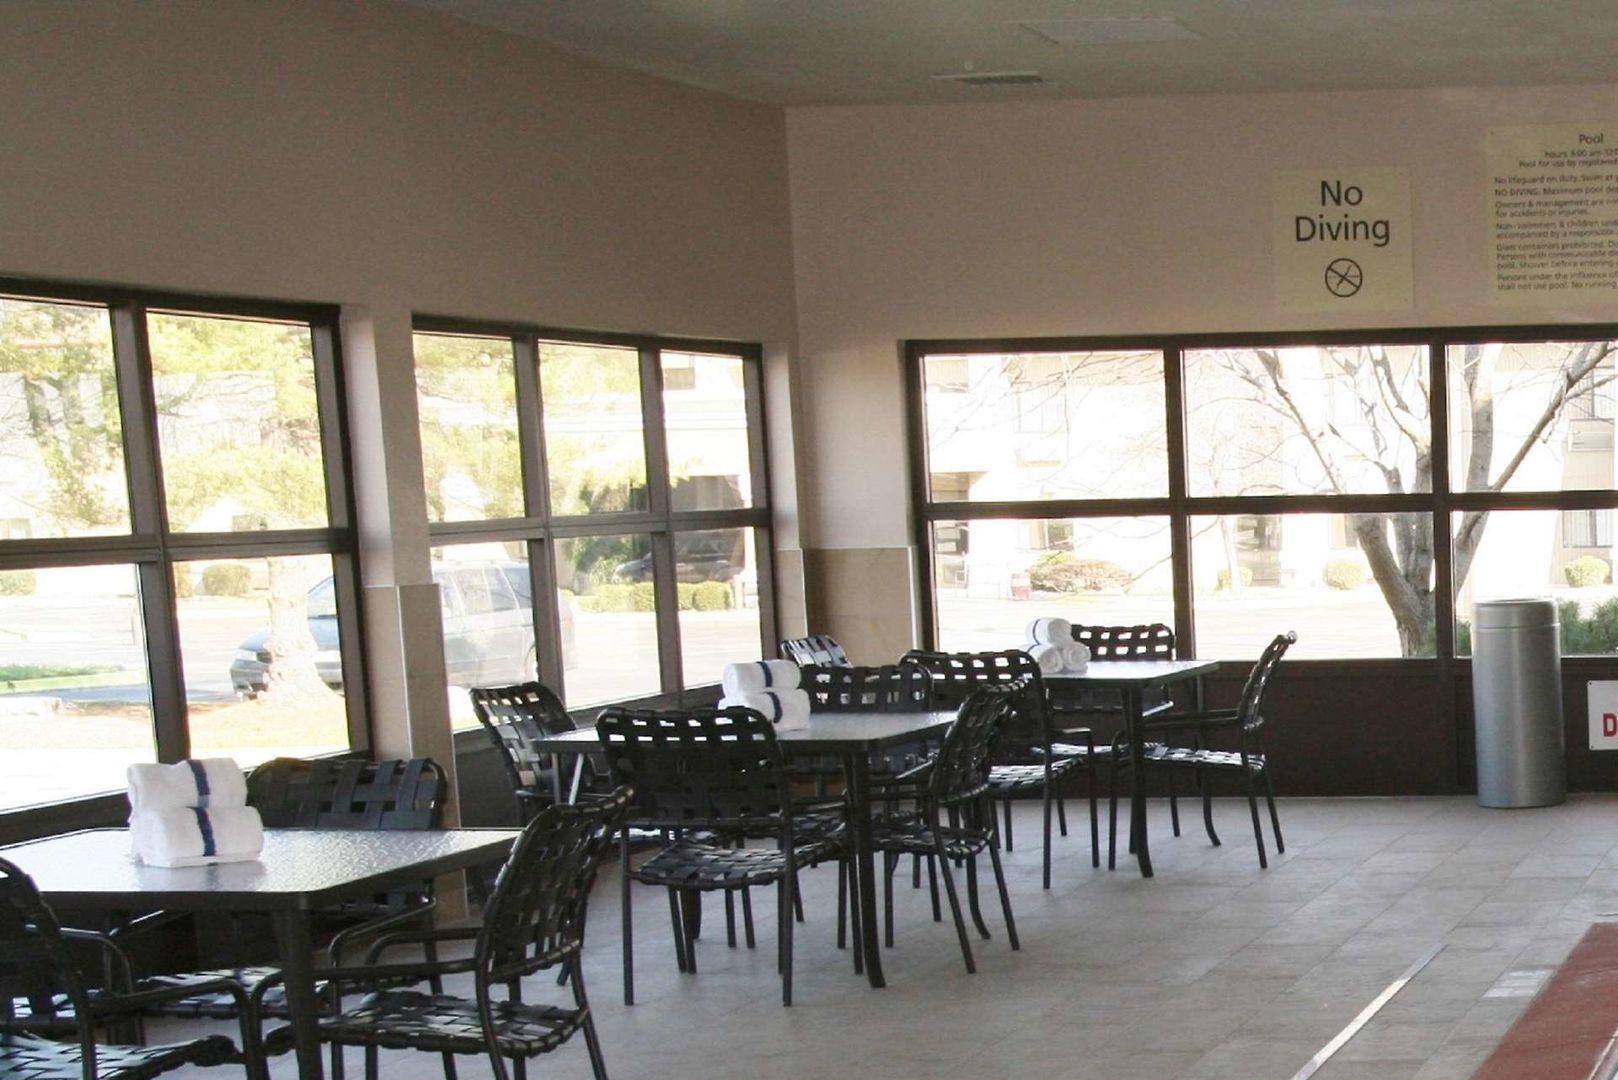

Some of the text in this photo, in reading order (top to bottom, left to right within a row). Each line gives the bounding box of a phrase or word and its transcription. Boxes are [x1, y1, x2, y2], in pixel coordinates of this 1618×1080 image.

[1578, 133, 1603, 144] Pool
[1519, 159, 1536, 168] Pool
[1538, 158, 1550, 167] for
[1552, 159, 1565, 167] use
[1566, 159, 1576, 168] by
[1578, 157, 1617, 167] registered
[1494, 176, 1507, 184] No
[1508, 175, 1544, 185] lifeguard
[1580, 174, 1603, 182] Swim
[1321, 180, 1363, 206] No
[1494, 188, 1507, 196] NO
[1543, 187, 1583, 195] Maximum
[1584, 185, 1604, 194] pool
[1495, 200, 1525, 208] Owners
[1528, 199, 1534, 207] &
[1536, 199, 1588, 209] management
[1495, 209, 1507, 217] for
[1509, 208, 1546, 217] accidents
[1559, 220, 1565, 228] &
[1567, 218, 1599, 228] children
[1295, 214, 1390, 247] Diving
[1496, 230, 1549, 240] accompanied
[1550, 230, 1559, 239] by
[1569, 228, 1614, 238] responsible
[1496, 243, 1516, 251] Glass
[1518, 242, 1560, 251] containers
[1608, 240, 1618, 248] Do
[1496, 252, 1527, 260] Persons
[1528, 250, 1546, 259] with
[1548, 248, 1606, 258] communicable
[1519, 260, 1549, 269] Shower
[1550, 259, 1578, 268] before
[1579, 258, 1614, 268] entering
[1497, 273, 1527, 282] Persons
[1528, 272, 1553, 281] under
[1554, 271, 1569, 280] the
[1570, 269, 1607, 279] influence
[1609, 269, 1618, 278] of
[1497, 281, 1516, 290] shall
[1518, 281, 1532, 290] not
[1533, 282, 1547, 290] use
[1571, 280, 1583, 289] No
[1585, 279, 1616, 290] running
